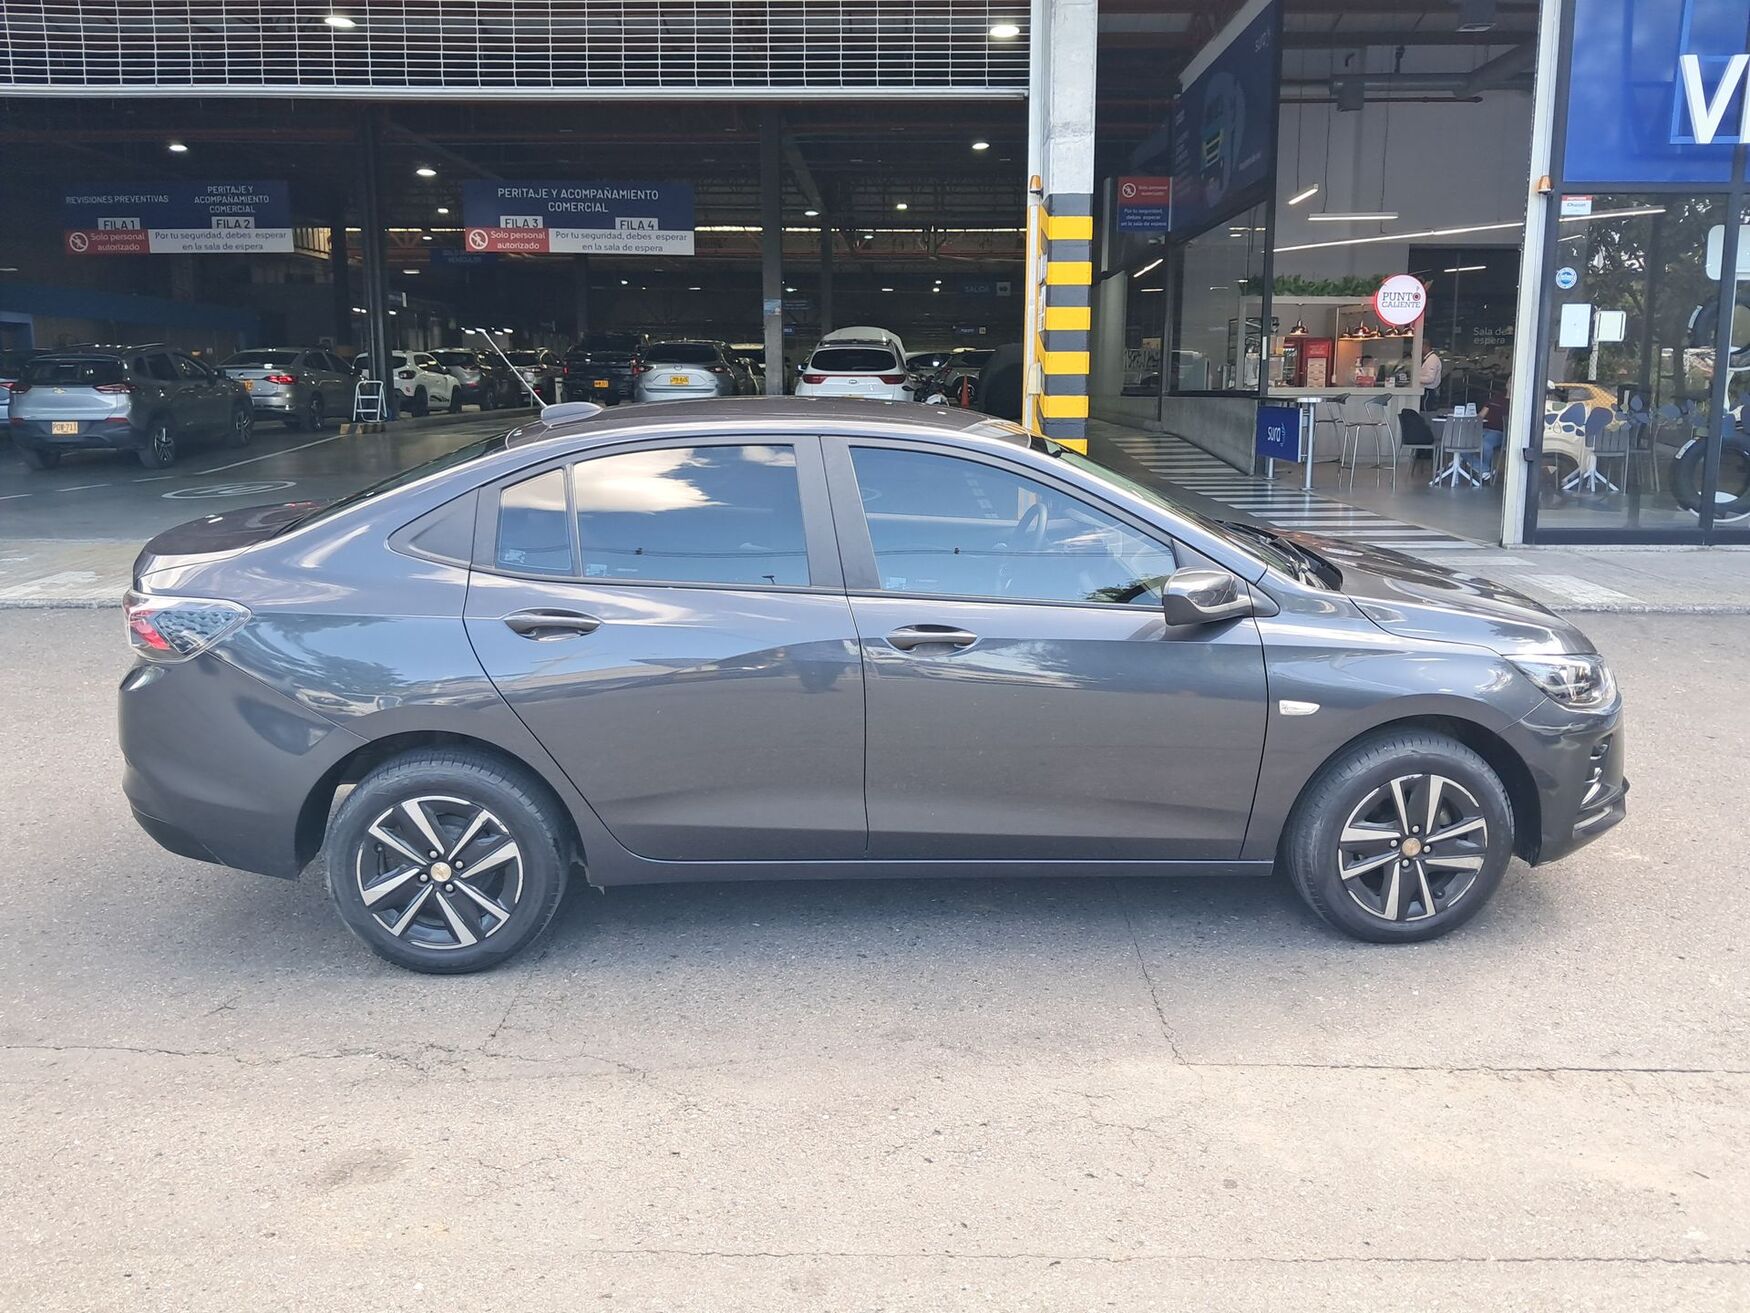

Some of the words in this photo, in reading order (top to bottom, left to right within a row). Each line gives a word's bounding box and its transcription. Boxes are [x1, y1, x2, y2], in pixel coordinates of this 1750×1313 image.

[207, 185, 246, 194] PERITAJE
[248, 185, 254, 194] Y
[497, 187, 549, 198] PERITAJE
[551, 188, 558, 198] Y
[560, 187, 659, 200] ACOMPAÑAMIENTO
[114, 194, 169, 203] PREVENTIVAS
[194, 194, 270, 204] ACOMPAÑAMIENTO
[209, 205, 256, 213] COMERCIAL
[548, 201, 609, 213] COMERCIAL
[103, 220, 128, 230] FILA
[131, 220, 136, 230] 1
[216, 219, 242, 229] FILA
[244, 219, 251, 229] 2
[505, 218, 530, 228] FILA
[532, 218, 539, 228] 3
[620, 220, 645, 230] FILA
[647, 220, 654, 230] 4
[90, 232, 109, 241] Solo
[110, 231, 145, 241] personal
[155, 231, 168, 239] Por
[170, 231, 179, 239] tu
[180, 231, 224, 241] seguridad,
[225, 231, 251, 239] debes
[255, 232, 287, 241] esperar
[490, 230, 509, 239] Solo
[510, 230, 546, 241] personal
[555, 231, 569, 239] Por
[571, 231, 580, 239] tu
[581, 232, 625, 241] seguridad,
[626, 232, 652, 240] debes
[655, 233, 687, 242] esperar
[97, 243, 140, 251] autorizado
[195, 242, 202, 250] la
[204, 242, 220, 250] sala
[222, 242, 233, 250] de
[235, 243, 263, 252] espera
[497, 241, 540, 249] autorizado
[595, 243, 602, 251] la
[604, 243, 620, 251] sala
[622, 243, 633, 251] de
[635, 244, 663, 253] espera
[1382, 292, 1421, 301] PUNTO
[1381, 301, 1421, 309] CALIENTE
[1473, 326, 1493, 336] Sala
[1473, 337, 1506, 345] espera
[1267, 426, 1281, 442] sura
